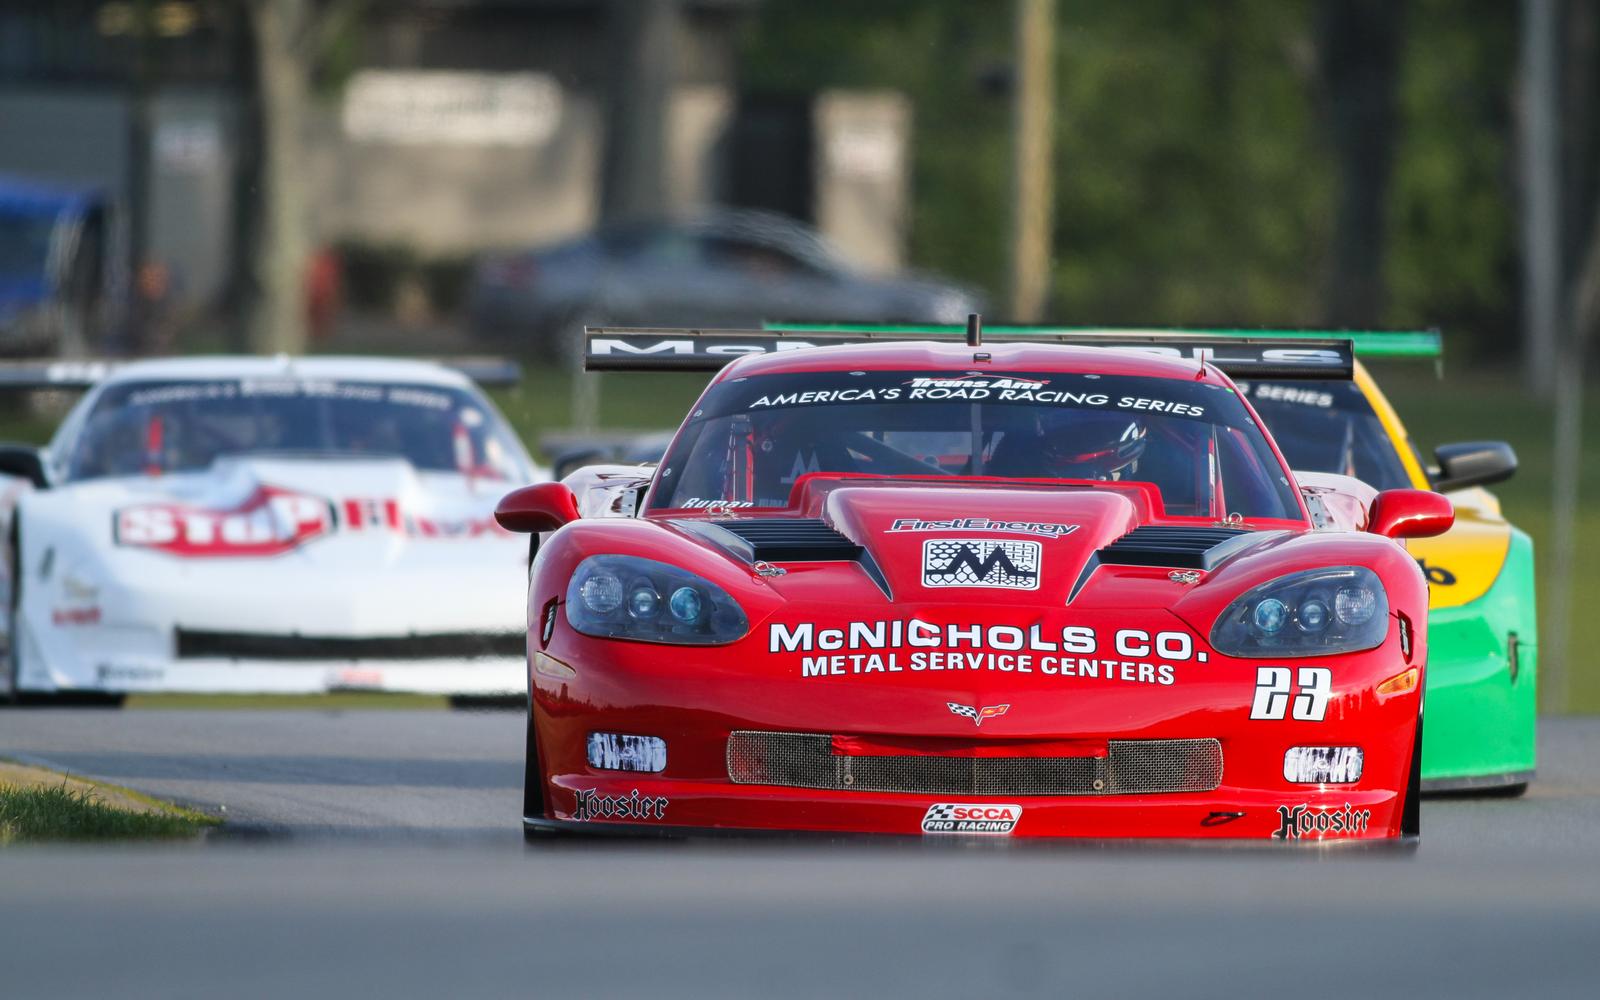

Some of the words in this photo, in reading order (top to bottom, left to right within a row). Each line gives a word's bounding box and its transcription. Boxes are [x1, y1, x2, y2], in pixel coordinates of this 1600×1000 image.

[910, 377, 988, 389] Trans
[988, 378, 1044, 390] Am
[1255, 384, 1334, 407] SERIES
[748, 388, 902, 409] AMERICA'S
[908, 388, 989, 400] ROAD
[998, 388, 1110, 405] RACING
[1117, 396, 1205, 417] SERIES
[891, 517, 1081, 537] FirstEnergy
[768, 617, 1097, 654] McNICHOLS
[1113, 627, 1210, 663] CO.
[801, 652, 904, 677] METAL
[909, 651, 1034, 673] SERVICE
[1040, 655, 1176, 686] CENTERS
[1249, 666, 1333, 722] 23
[572, 787, 670, 822] Hoosier
[952, 807, 1014, 820] SCCA
[925, 821, 954, 831] PRO
[956, 821, 1011, 831] RACING
[1271, 801, 1371, 839] Hoosier
